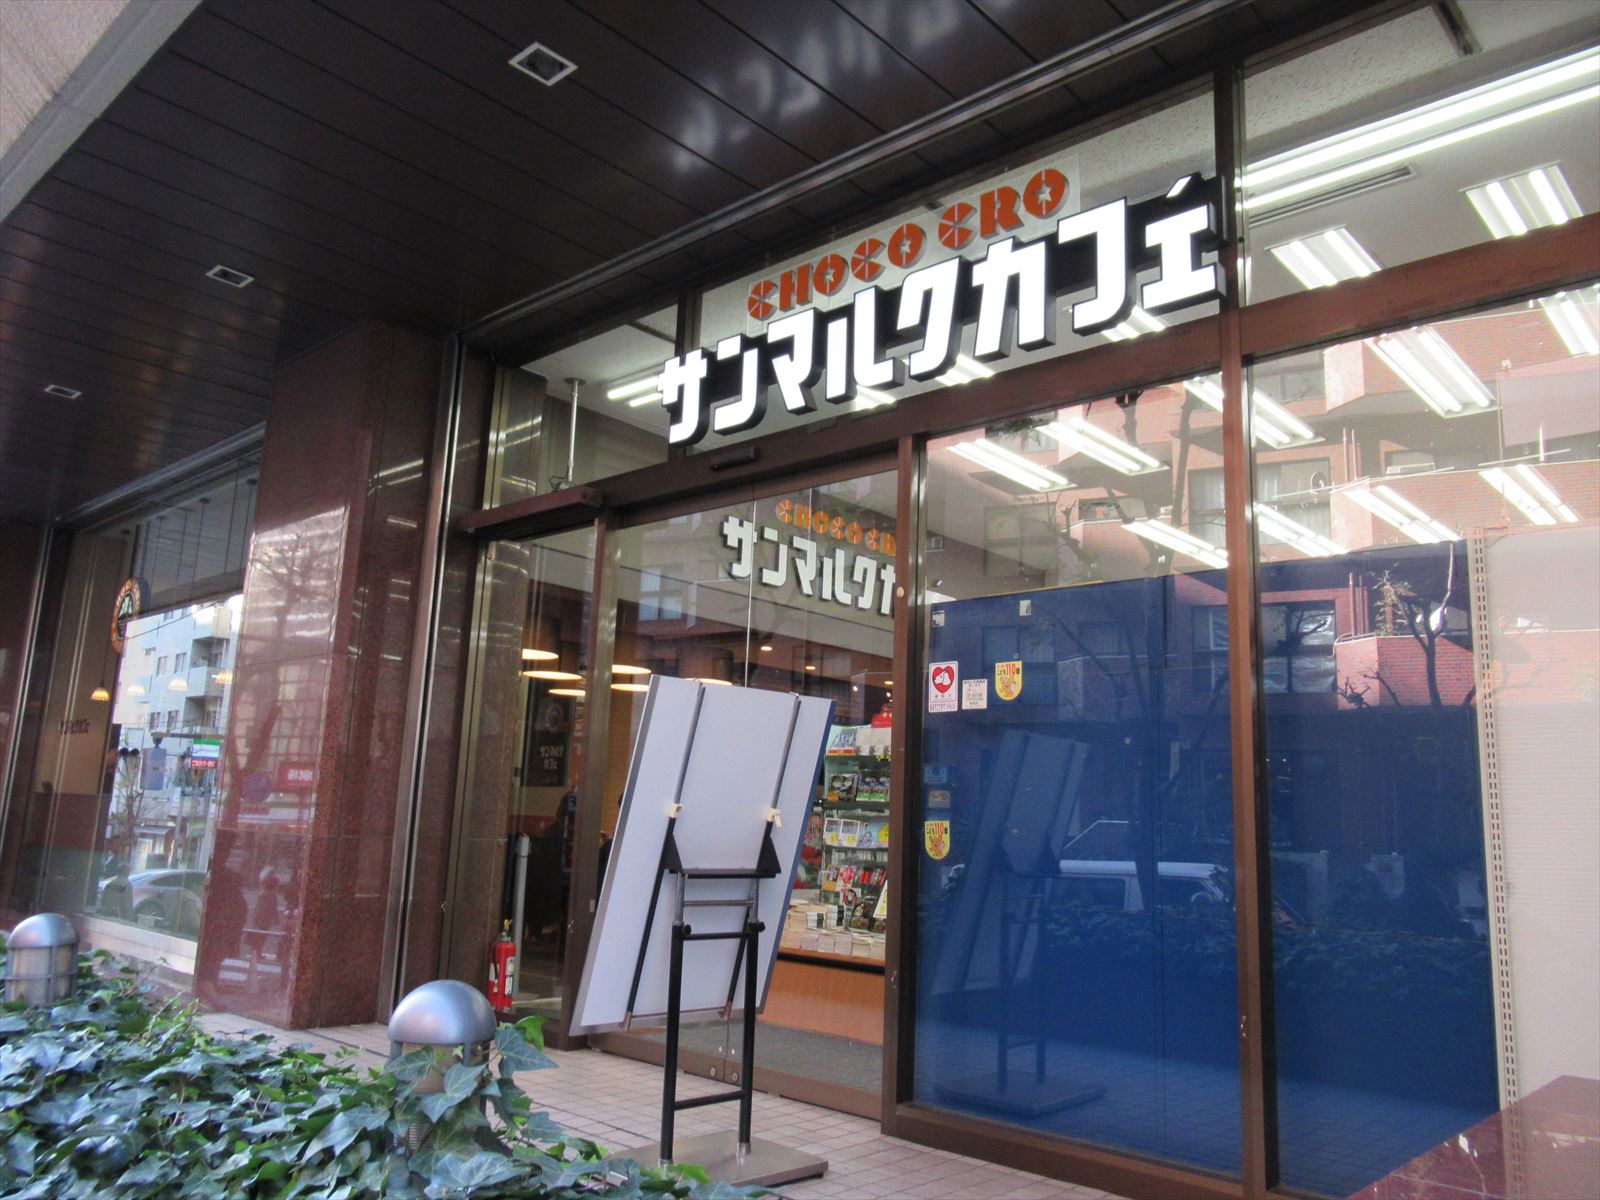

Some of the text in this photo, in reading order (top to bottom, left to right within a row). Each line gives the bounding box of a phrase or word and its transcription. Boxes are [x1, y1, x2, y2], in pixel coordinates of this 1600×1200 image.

[658, 175, 1221, 444] サンマルクカフェ
[747, 167, 1070, 321] CHOCO CRO
[775, 499, 863, 545] CHOCO
